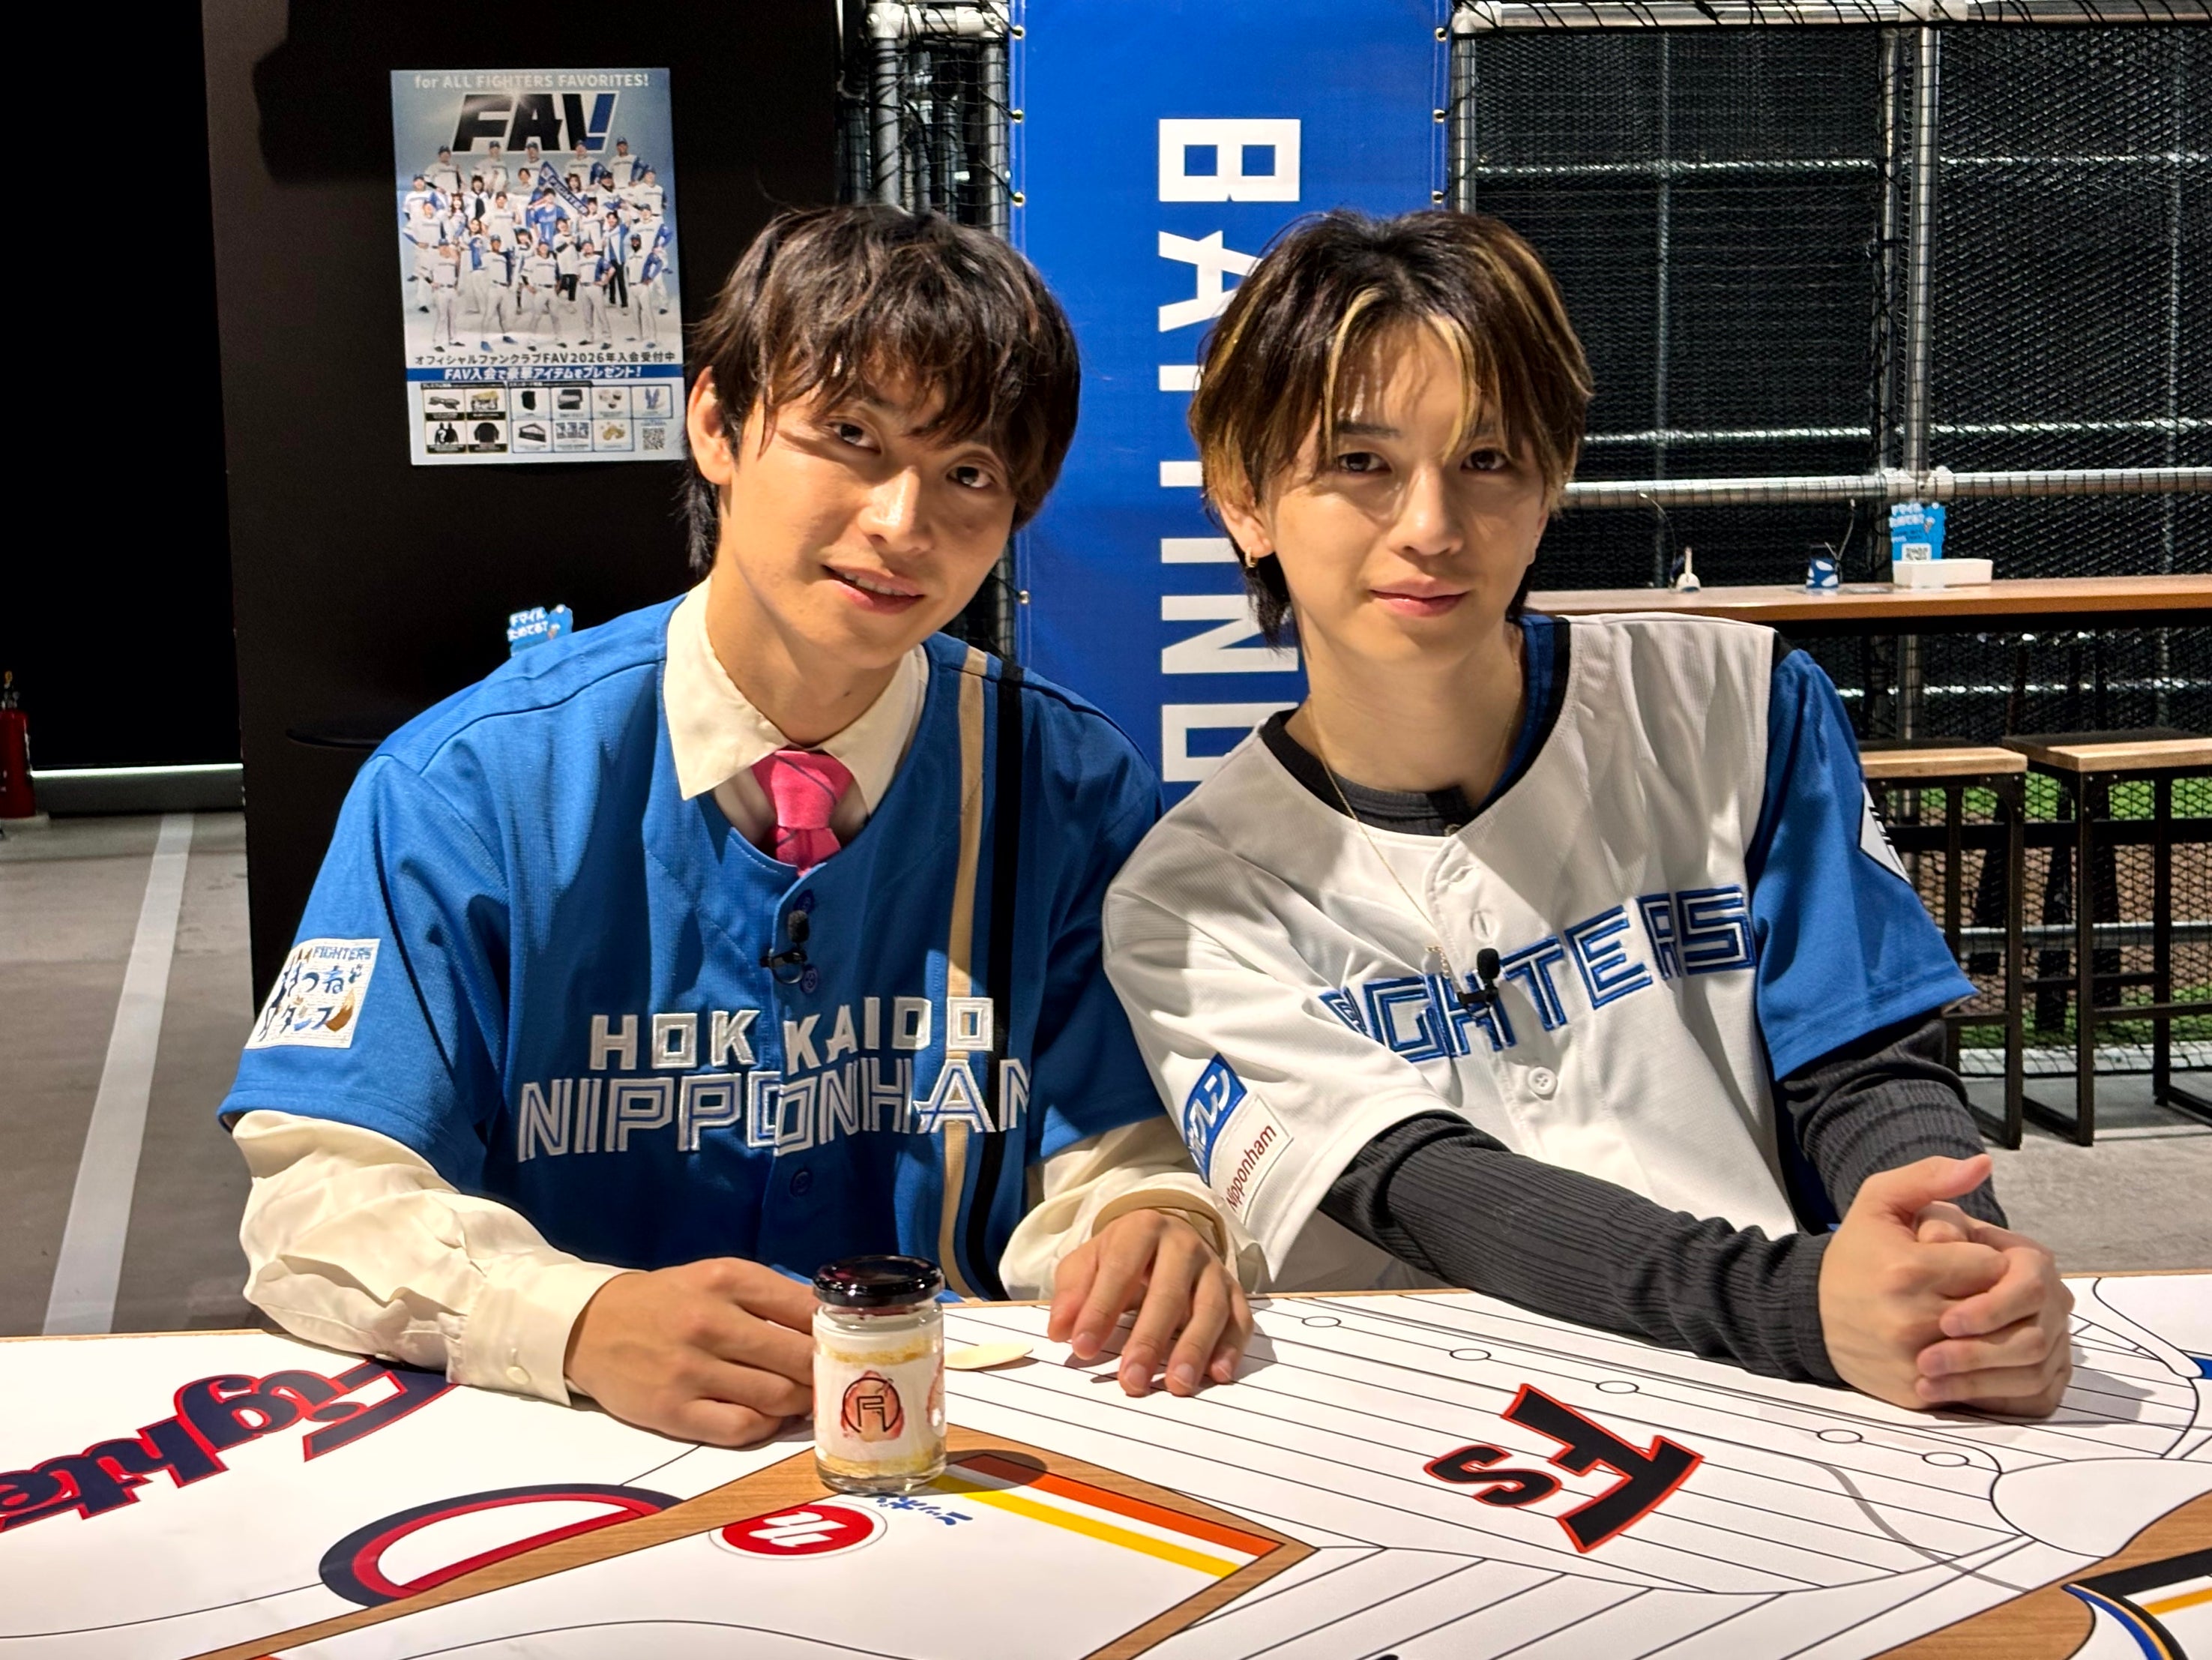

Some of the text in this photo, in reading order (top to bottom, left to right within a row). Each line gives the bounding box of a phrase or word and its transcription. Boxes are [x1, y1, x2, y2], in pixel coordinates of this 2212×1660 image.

[415, 73, 649, 88] for ALL FIGHTERS FAVORITES!
[312, 945, 373, 960] FIGHTERS
[589, 996, 993, 1076] HOKKAIDO
[1226, 1125, 1277, 1213] Nipponham
